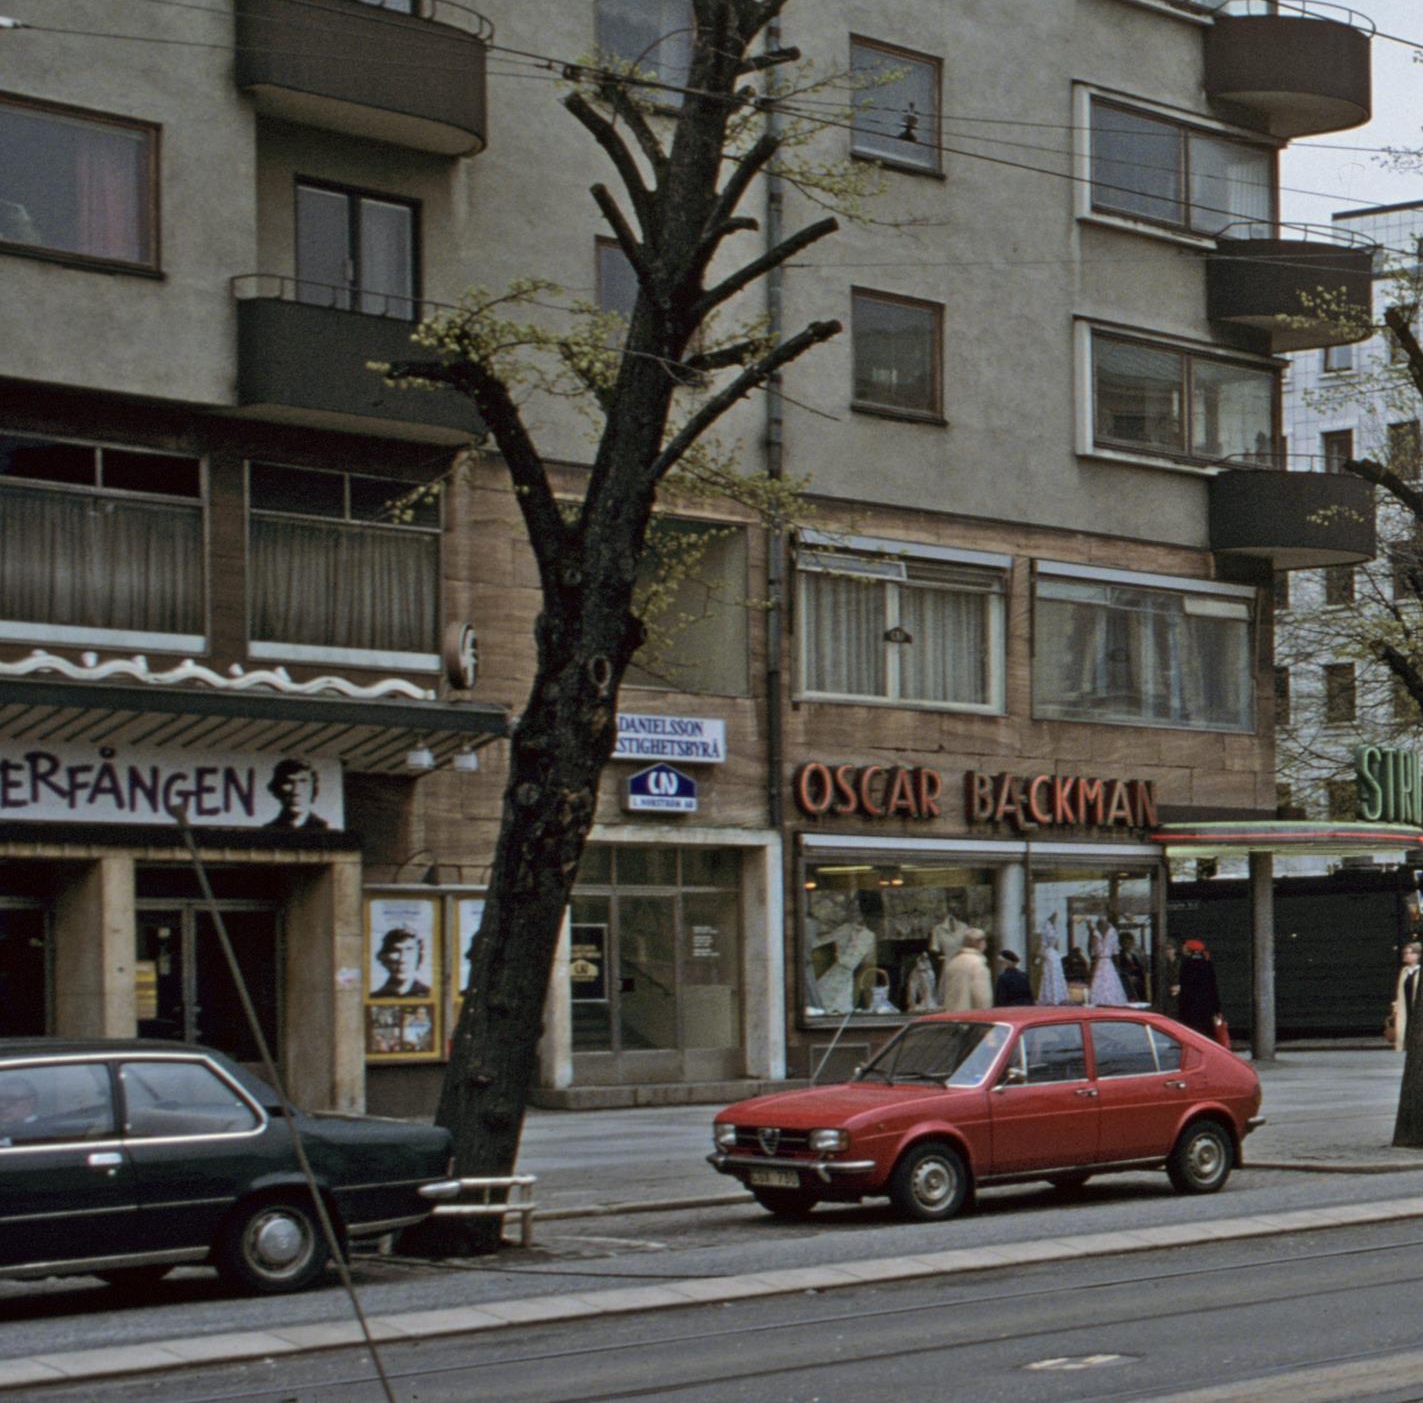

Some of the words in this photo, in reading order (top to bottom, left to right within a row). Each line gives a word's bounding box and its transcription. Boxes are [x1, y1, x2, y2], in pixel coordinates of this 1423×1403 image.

[619, 716, 704, 737] DANIELSSON
[799, 760, 943, 817] OSCAR
[968, 771, 1158, 828] BACKMAN
